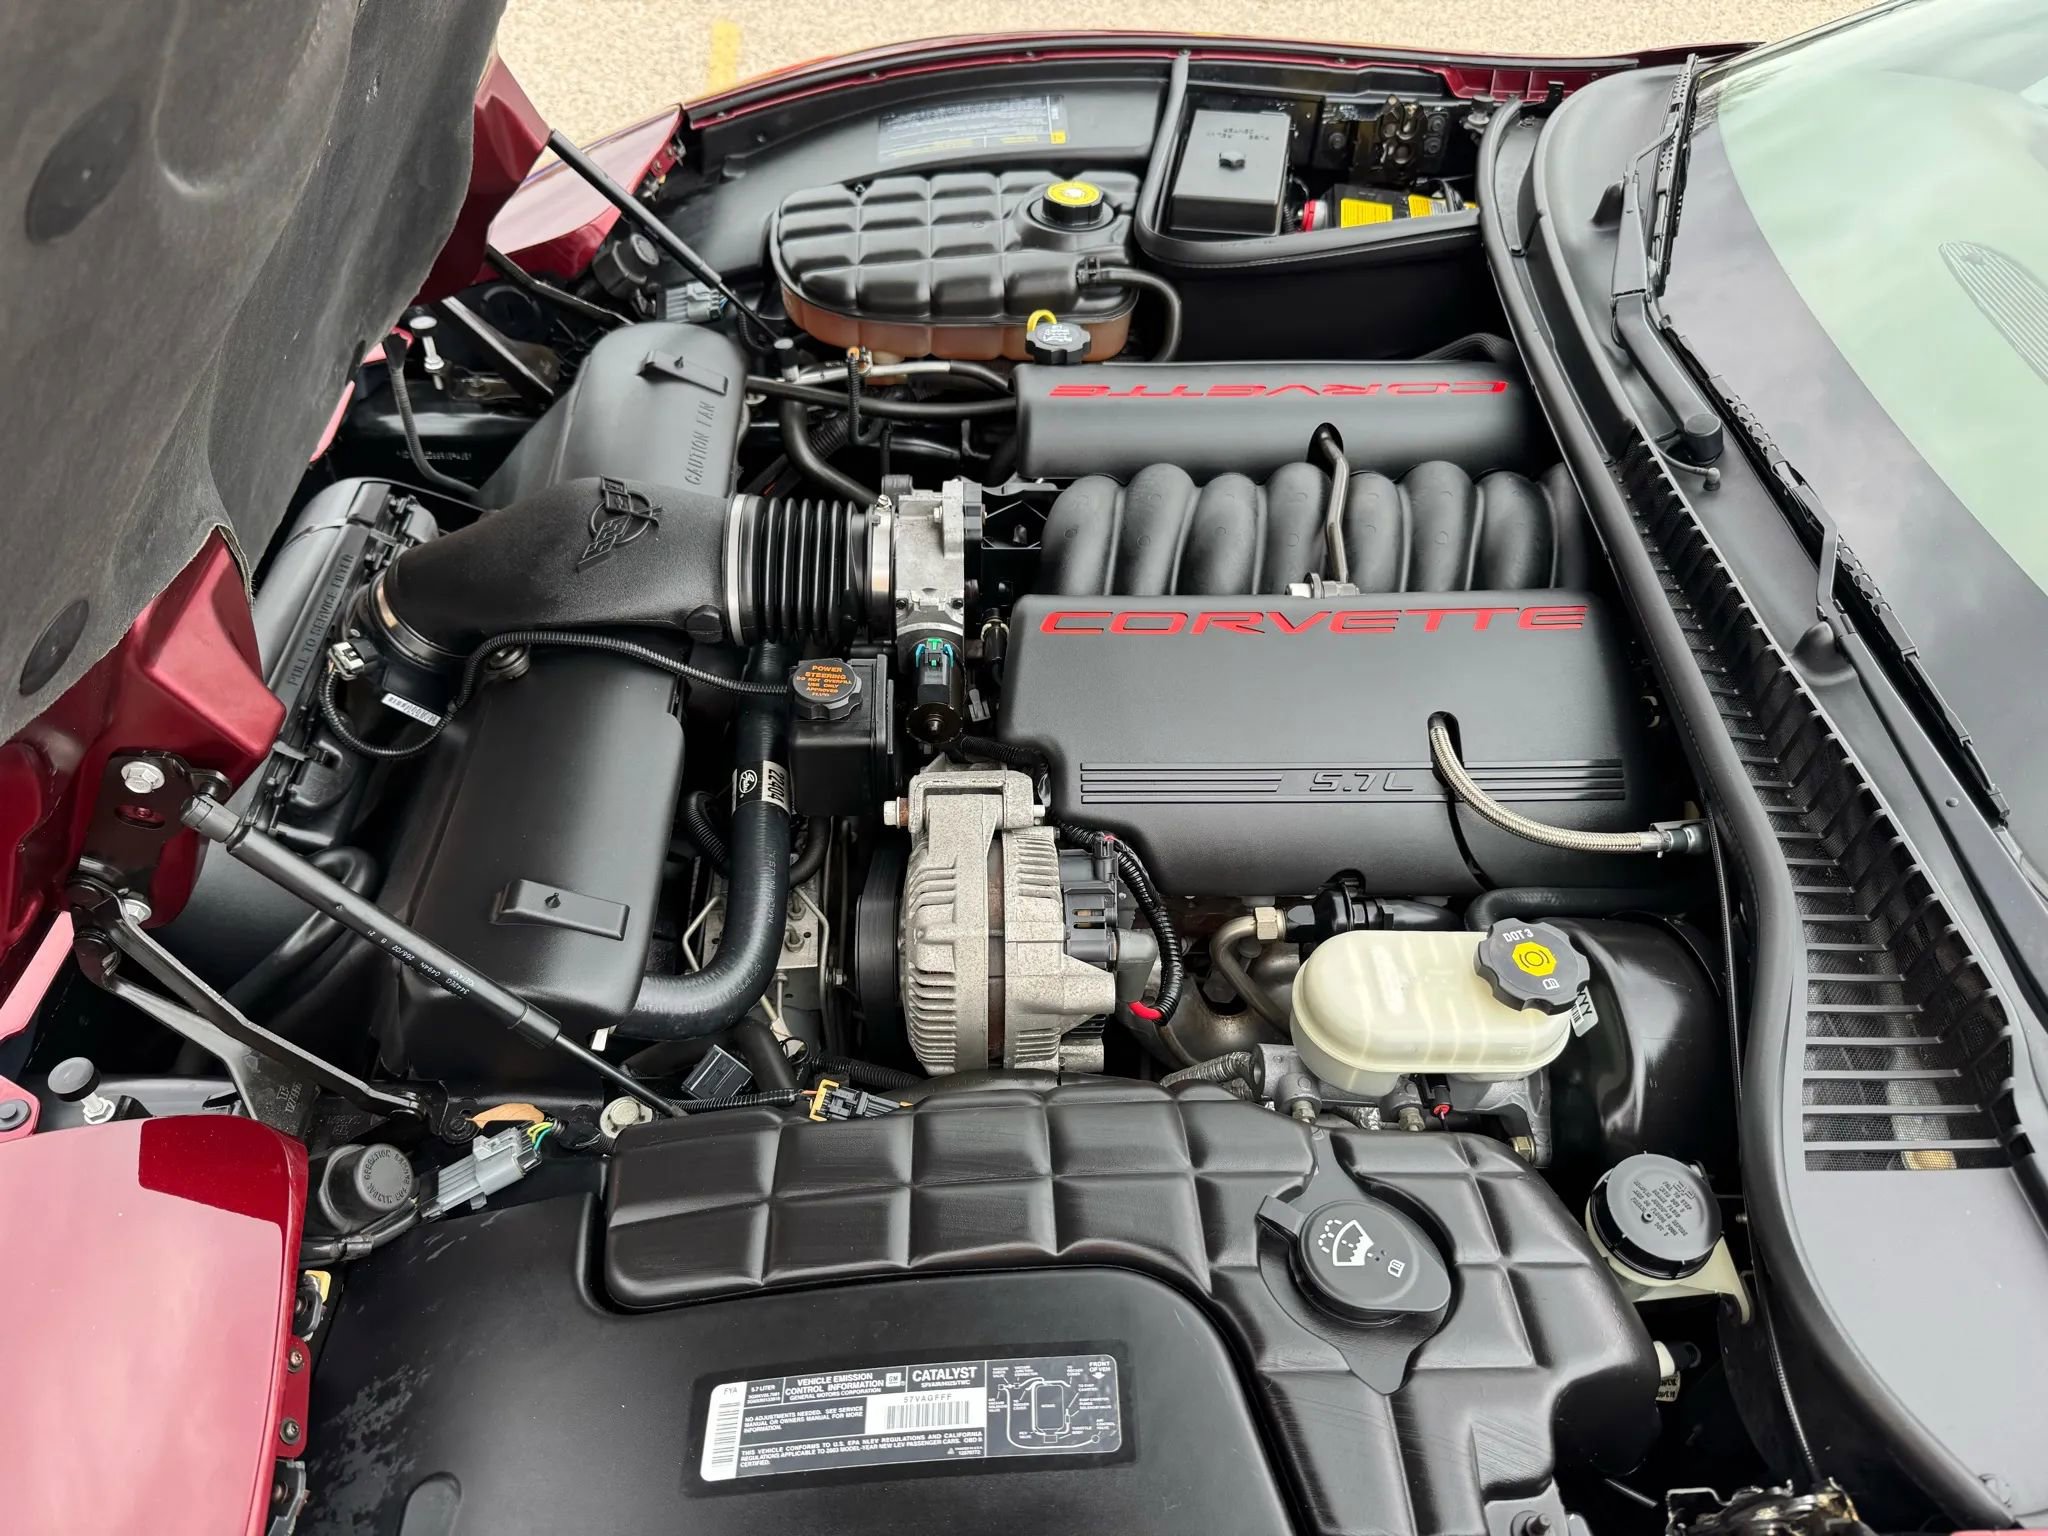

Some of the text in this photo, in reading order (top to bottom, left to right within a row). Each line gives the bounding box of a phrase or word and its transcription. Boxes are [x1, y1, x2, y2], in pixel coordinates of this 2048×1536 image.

[1049, 380, 1508, 397] CORVETTE
[684, 431, 710, 485] CAUTION
[288, 553, 354, 687] PULL TO SERVICE FILTER
[1039, 605, 1589, 635] CORVETTE
[805, 671, 846, 679] STEERING
[768, 768, 784, 805] 22404
[1309, 772, 1415, 792] 5.7L
[1502, 928, 1534, 942] DOT 3
[797, 1373, 873, 1387] VEHICLE EMISSION
[912, 1367, 977, 1382] CATALYST
[785, 1380, 884, 1396] CONTROL INFORMATION
[790, 1392, 816, 1401] GENERAL
[817, 1390, 840, 1399] MOTORS
[841, 1387, 881, 1397] CORPORATION
[755, 1412, 796, 1421] ADJUSTMENTS
[838, 1406, 864, 1414] SERVICE
[806, 1414, 831, 1422] MANUAL
[758, 1446, 783, 1454] VEHICLE
[785, 1443, 820, 1451] CONFORMS
[881, 1434, 925, 1443] REGULATIONS
[943, 1431, 983, 1439] CALIFORNIA
[781, 1449, 816, 1458] APPLICABLE
